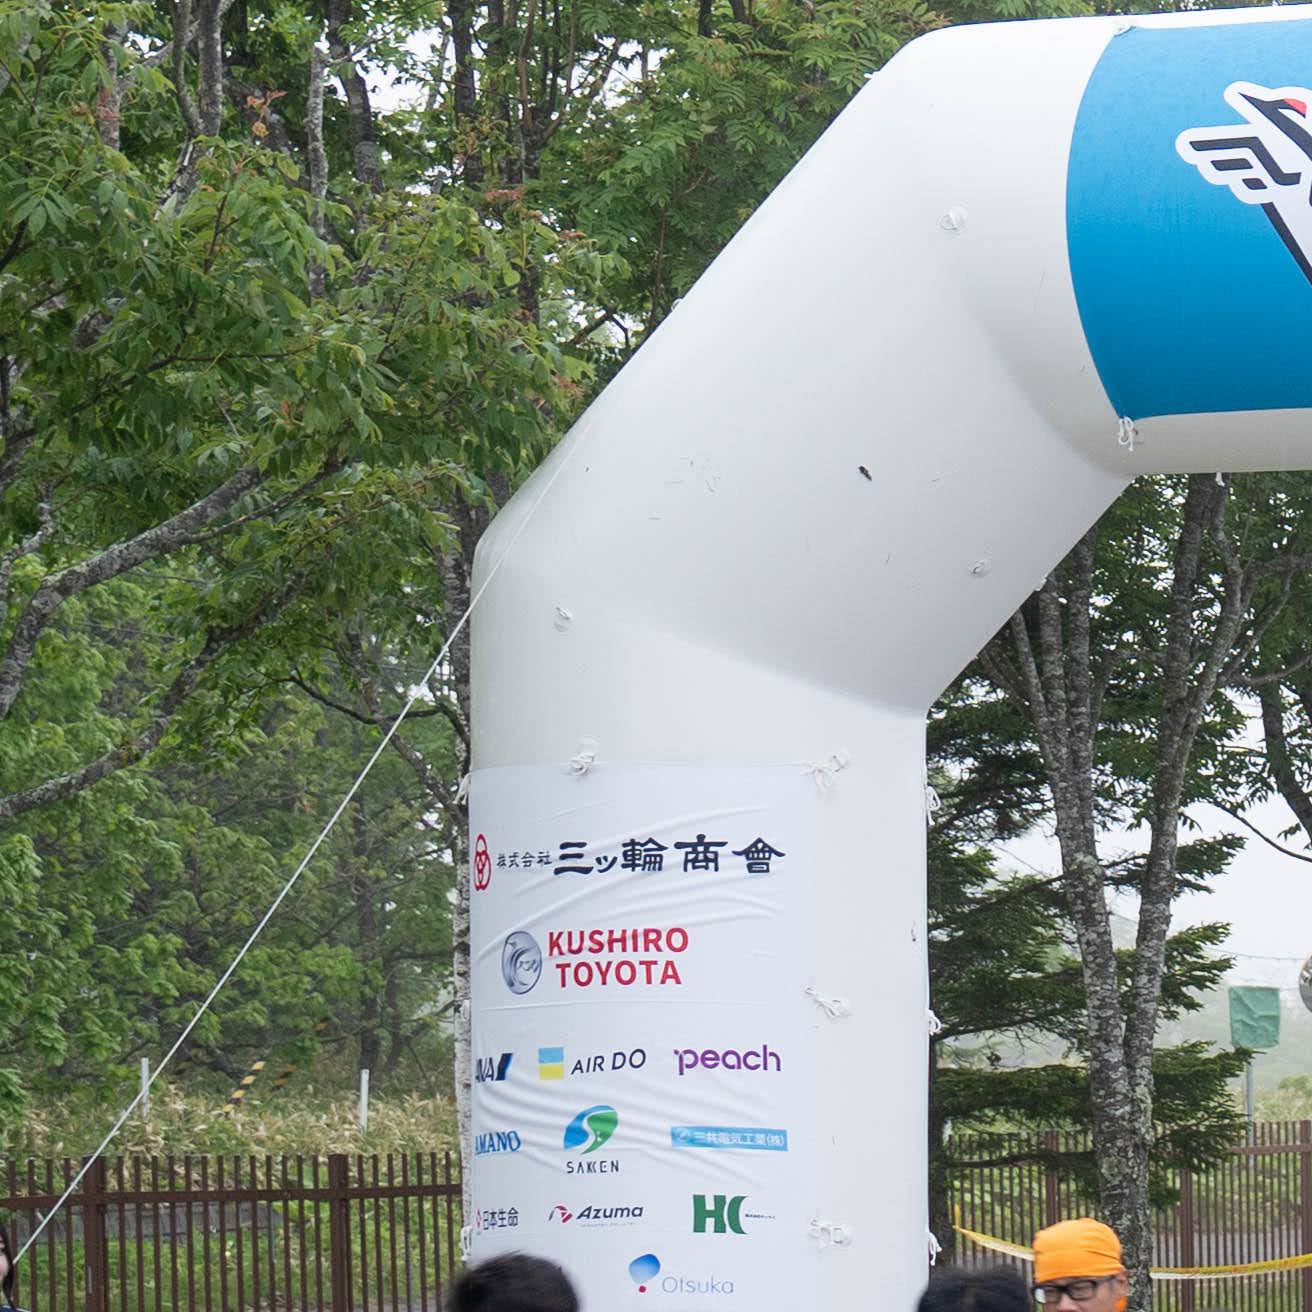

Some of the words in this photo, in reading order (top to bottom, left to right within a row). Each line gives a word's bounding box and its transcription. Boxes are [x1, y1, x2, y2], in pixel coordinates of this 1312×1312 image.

[548, 926, 689, 957] KUSHIRO
[555, 959, 682, 988] TOYOTA
[571, 1055, 604, 1075] AIR
[612, 1049, 646, 1070] DO
[673, 1045, 782, 1076] peach
[576, 1205, 644, 1220] Azuma
[661, 1274, 734, 1295] Otsuka
